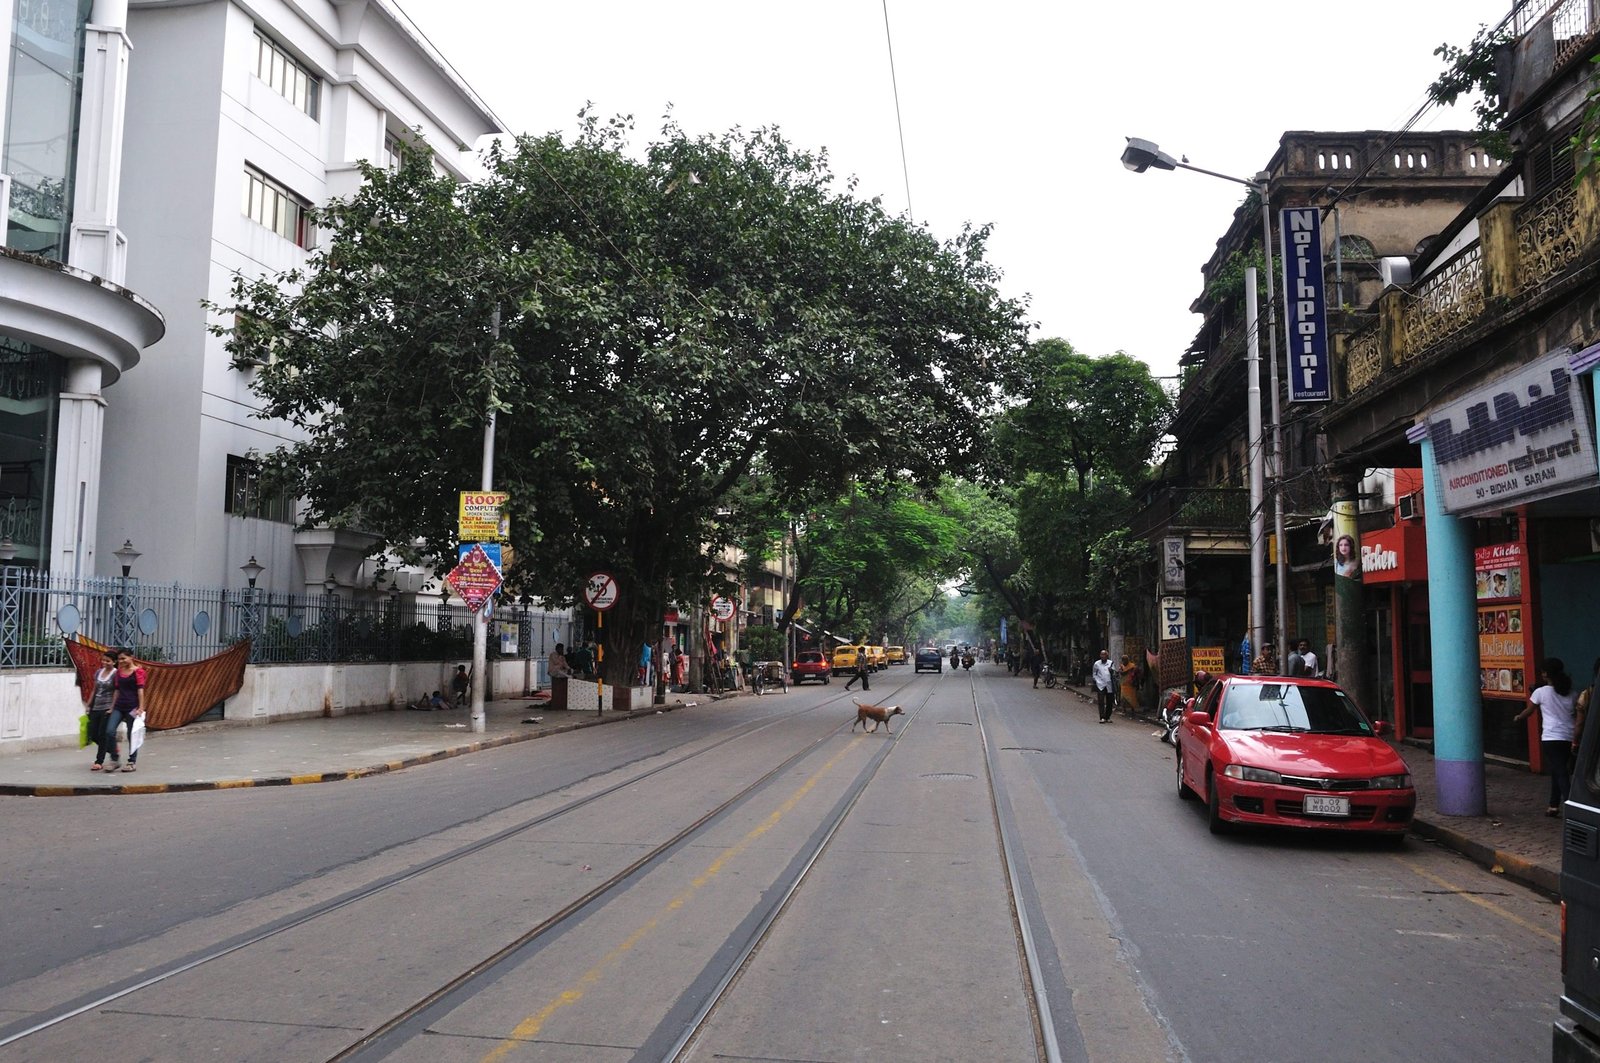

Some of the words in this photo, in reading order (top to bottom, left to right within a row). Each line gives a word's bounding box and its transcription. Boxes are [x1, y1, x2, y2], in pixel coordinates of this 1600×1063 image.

[1294, 390, 1327, 398] restaurant
[1448, 463, 1509, 491] AIRCONDITIONED
[1490, 479, 1518, 495] BIDHAN
[1524, 467, 1556, 487] SARANI
[465, 495, 505, 505] ROOT
[1361, 543, 1398, 573] itchen
